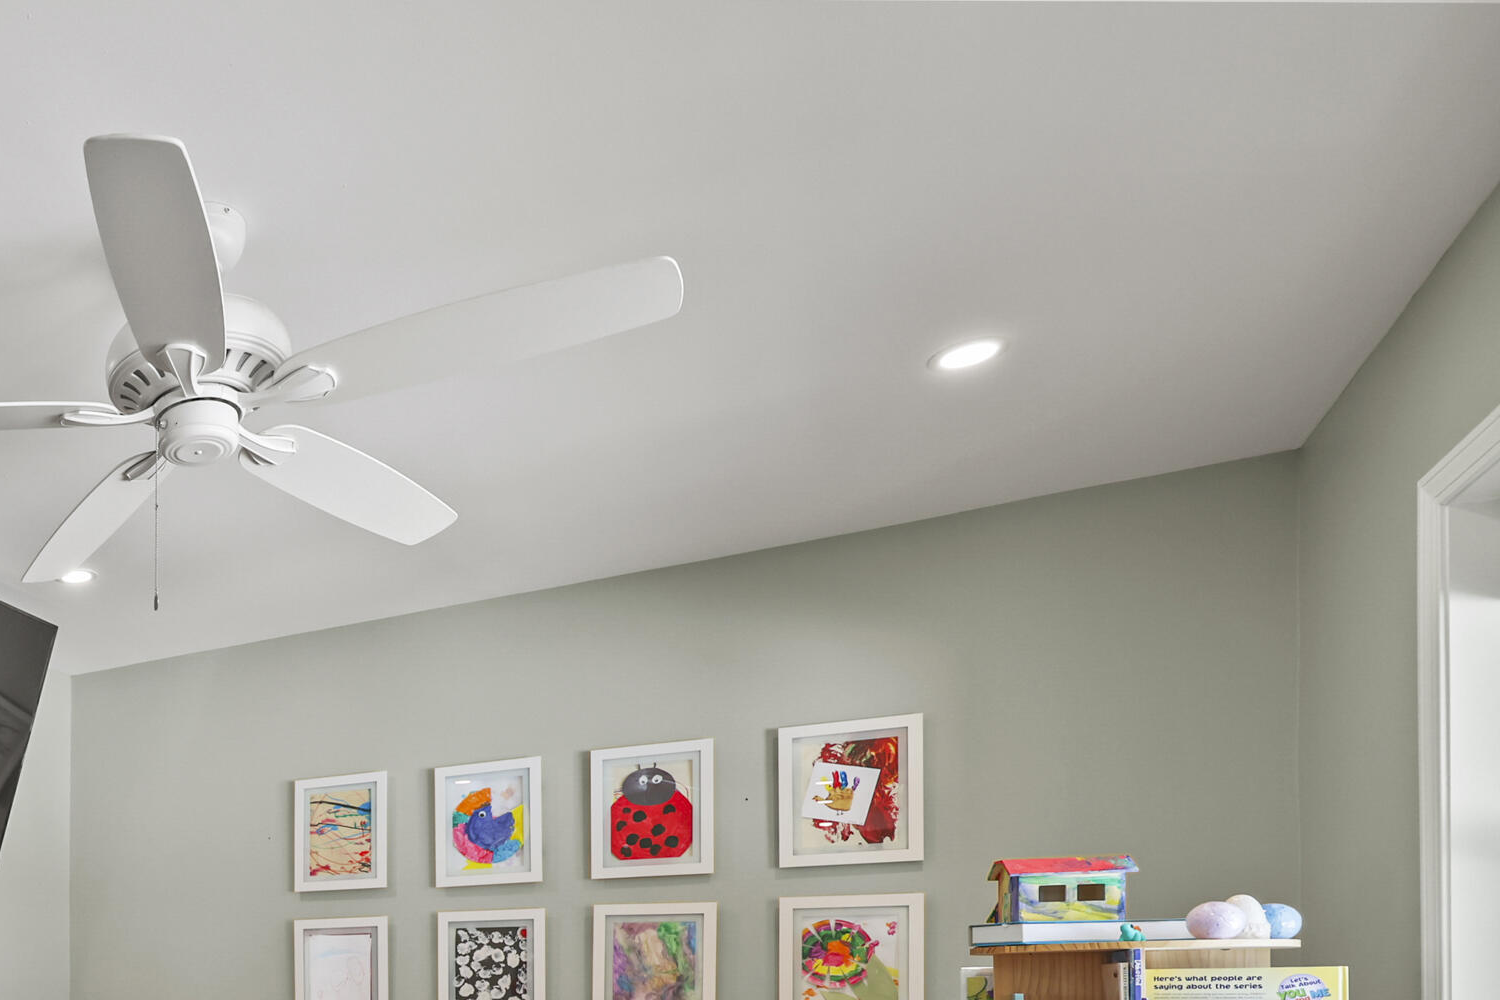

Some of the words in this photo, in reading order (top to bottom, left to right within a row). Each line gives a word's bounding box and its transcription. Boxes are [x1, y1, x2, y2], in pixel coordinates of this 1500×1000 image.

[1210, 975, 1243, 983] people
[1153, 983, 1183, 991] saying
[1309, 987, 1332, 999] ME
